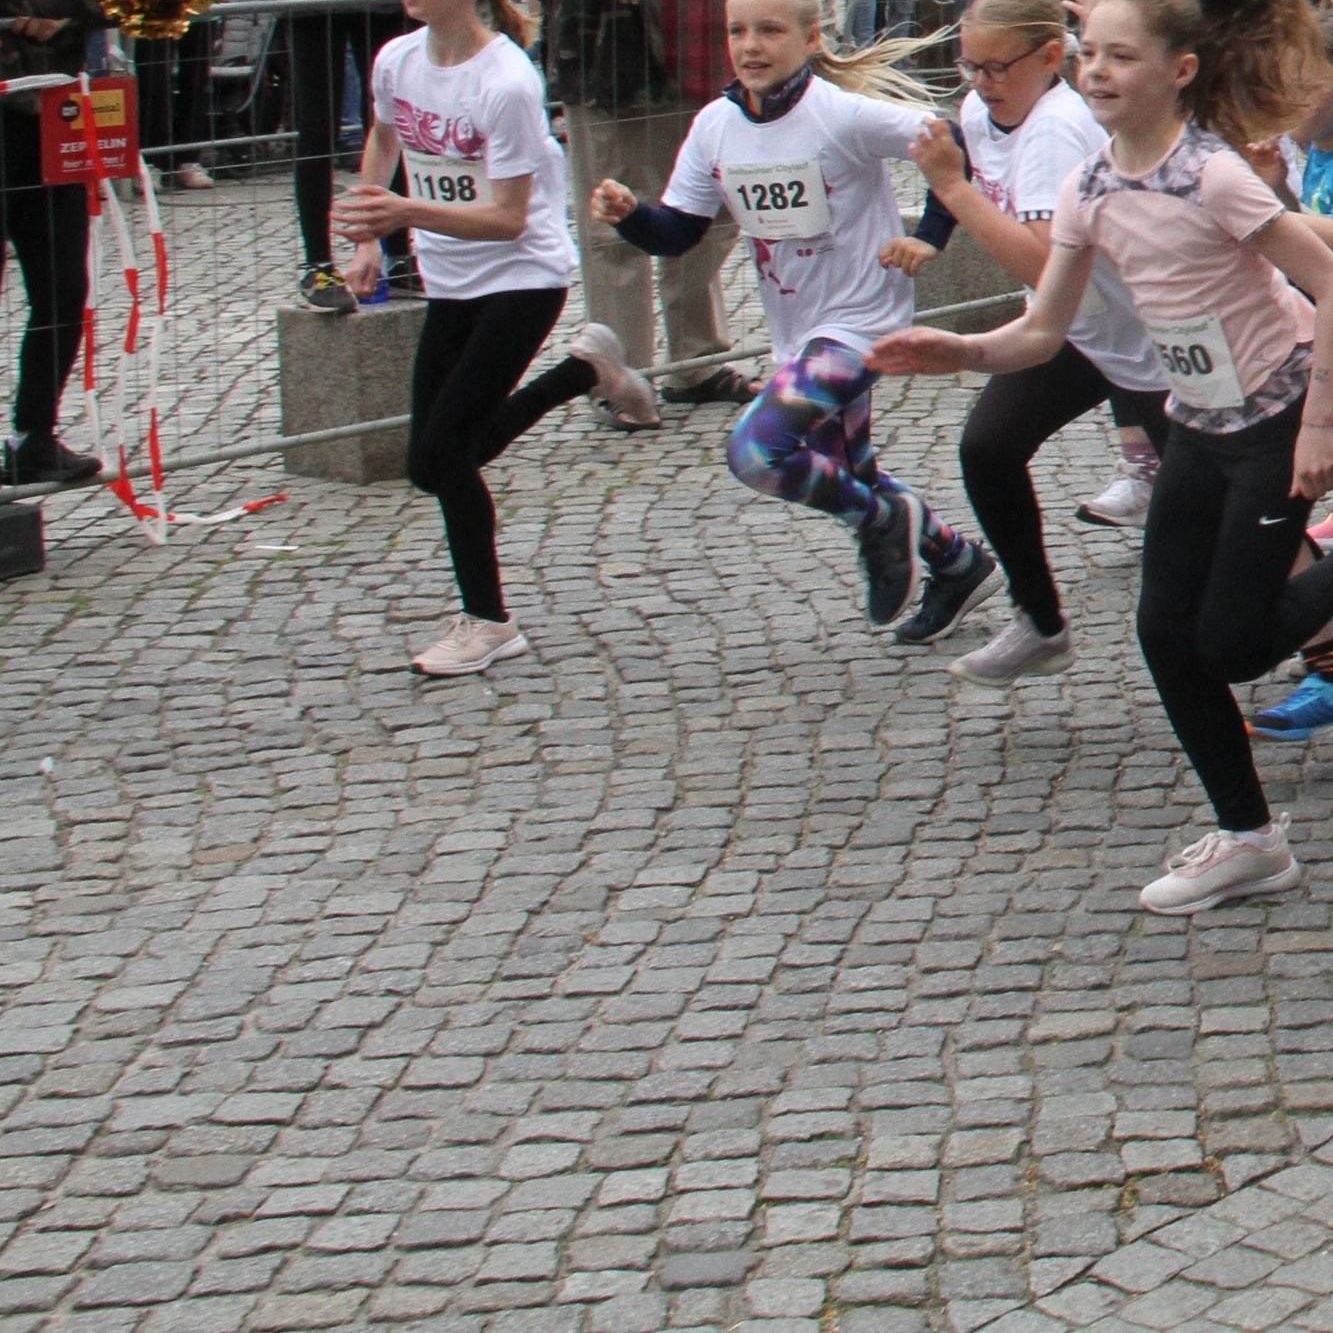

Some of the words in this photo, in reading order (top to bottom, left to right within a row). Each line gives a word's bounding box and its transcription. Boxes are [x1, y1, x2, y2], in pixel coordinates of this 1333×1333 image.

[60, 138, 127, 154] ZEPELIN
[414, 172, 477, 202] 1198
[737, 180, 809, 211] 1282
